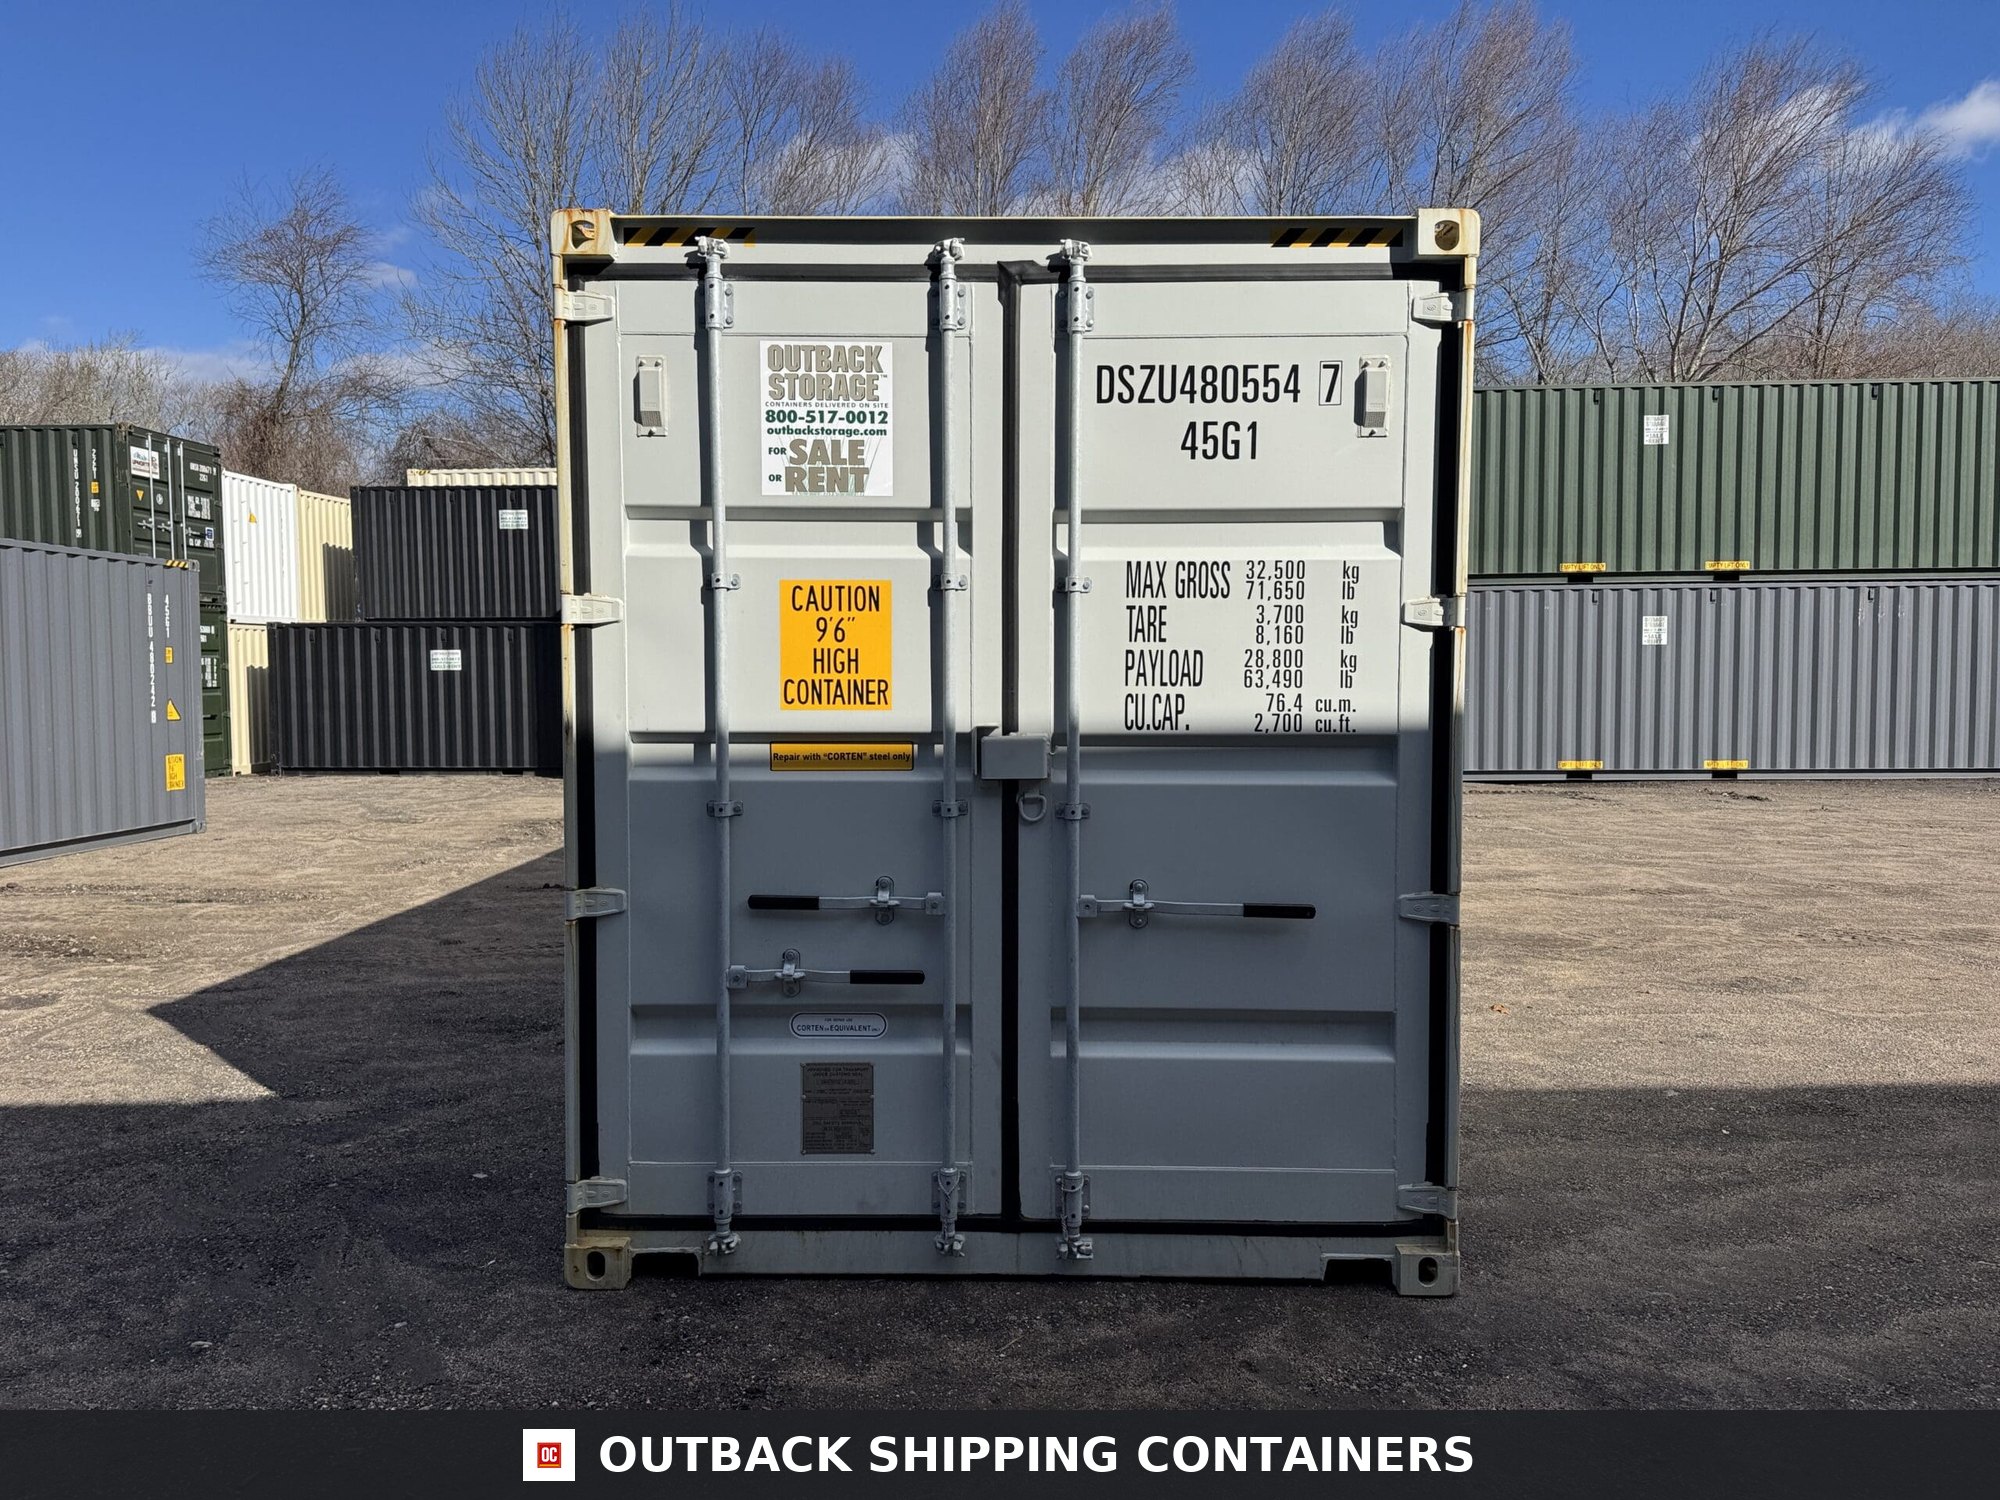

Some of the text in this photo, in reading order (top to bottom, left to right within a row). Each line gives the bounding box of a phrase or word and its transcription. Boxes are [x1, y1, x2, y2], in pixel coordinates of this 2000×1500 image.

[768, 344, 883, 373] OUTBACK
[768, 374, 880, 401] STORAGE
[1096, 364, 1340, 404] DSZU480554 7
[766, 410, 888, 424] 800-517-0012
[767, 426, 887, 437] outbackstorage.com
[1181, 421, 1258, 460] 45G1
[789, 439, 864, 465] SALE
[785, 467, 869, 492] RENT
[1126, 560, 1359, 598] MAX GROSS 32,500 kg
[1246, 580, 1355, 601] 71,650 lb
[792, 585, 880, 612] CAUTION
[1126, 605, 1358, 643] TARE 3,700 kg
[1256, 625, 1353, 645] 8,160 lb
[813, 648, 859, 674] HIGH
[1125, 649, 1357, 687] PAYLOAD 28,800 kg
[784, 679, 888, 705] CONTAINER
[1244, 669, 1352, 689] 63,490 lb
[1124, 694, 1356, 731] CU.CAP. 76.4 cu.m.
[1254, 713, 1356, 733] 2,700 cu.ft.
[774, 753, 800, 762] Repair
